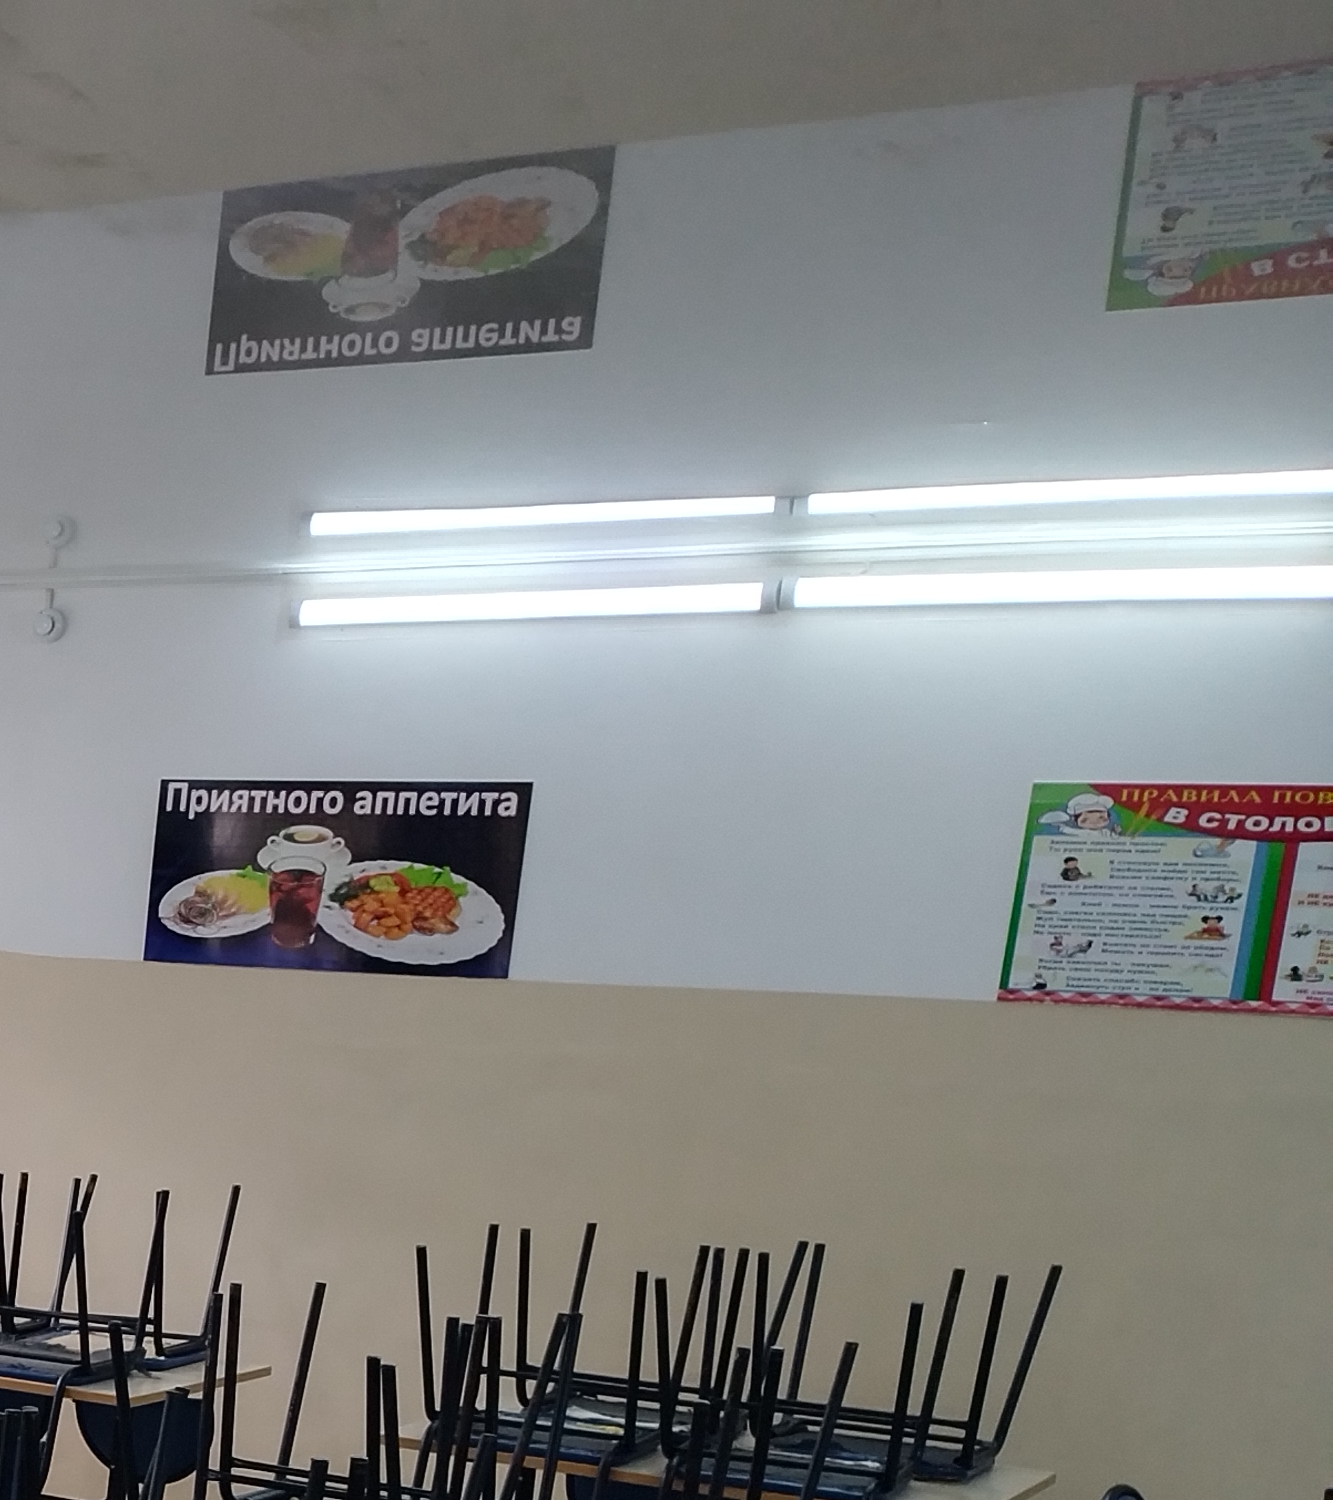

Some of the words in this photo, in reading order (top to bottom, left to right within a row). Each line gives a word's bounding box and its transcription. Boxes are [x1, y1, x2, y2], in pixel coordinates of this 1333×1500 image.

[165, 782, 343, 819] Приятного
[353, 787, 518, 817] аппетита
[1120, 788, 1263, 804] ПРАВИЛА
[1163, 806, 1189, 824] В
